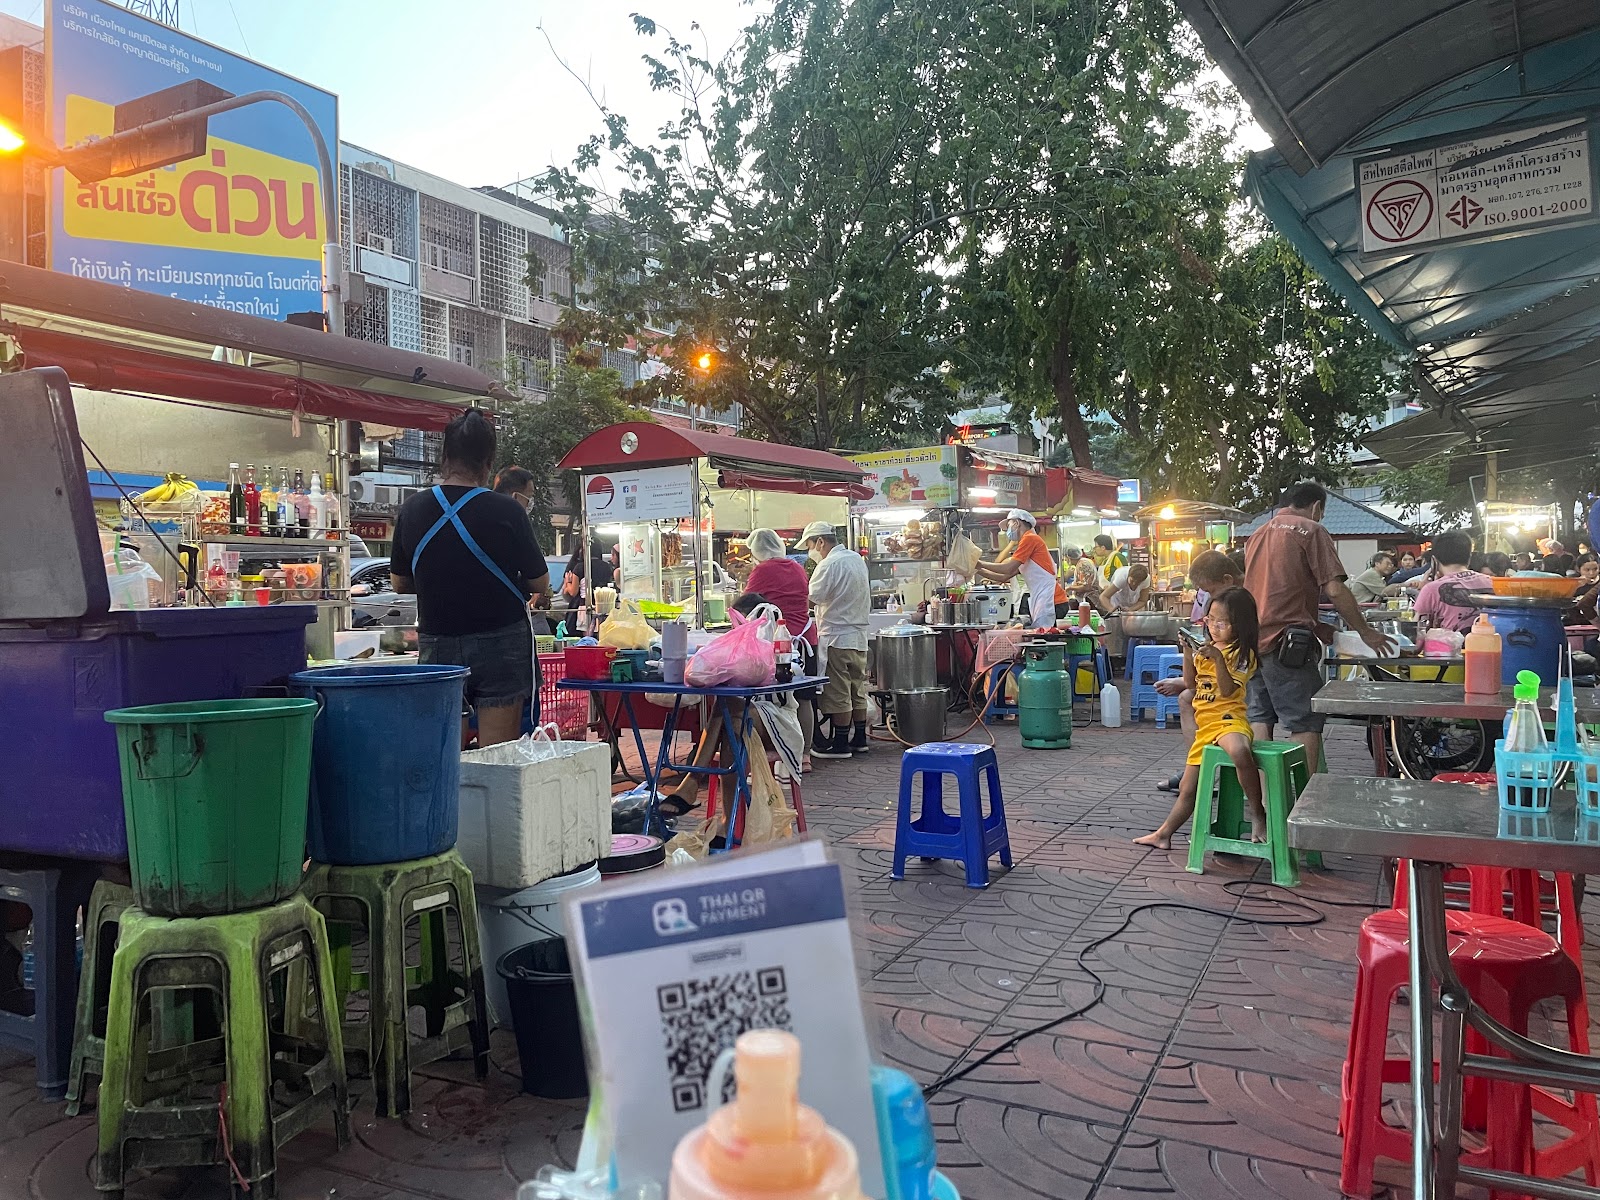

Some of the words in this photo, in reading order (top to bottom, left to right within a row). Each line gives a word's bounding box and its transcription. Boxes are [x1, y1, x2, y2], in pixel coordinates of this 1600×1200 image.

[63, 4, 88, 20] บริษัท
[90, 14, 126, 35] เมืองไทย
[128, 29, 168, 51] แคปปิตอล
[169, 44, 190, 60] จำกัด
[191, 55, 223, 73] (มหาชน)
[63, 19, 121, 47] บริการใกล้ชิด
[122, 41, 190, 74] ดุจญาติมิตรที่รู้ใจ
[1363, 151, 1434, 180] สหไทยสตีลไพพ์
[1441, 164, 1562, 195] มาตรฐานอุตสาหกรรม
[179, 148, 318, 240] ด่วน
[1563, 180, 1583, 191] 1228
[1484, 197, 1588, 226] ISO.9001-2000
[70, 256, 132, 287] ให้เงินกู้
[136, 263, 264, 291] ทะเบียนรถทุกชนิด
[267, 269, 322, 292] โฉนดที่ดิ
[698, 891, 738, 910] THAI
[741, 887, 766, 905] QR
[700, 902, 766, 925] PAYMENT
